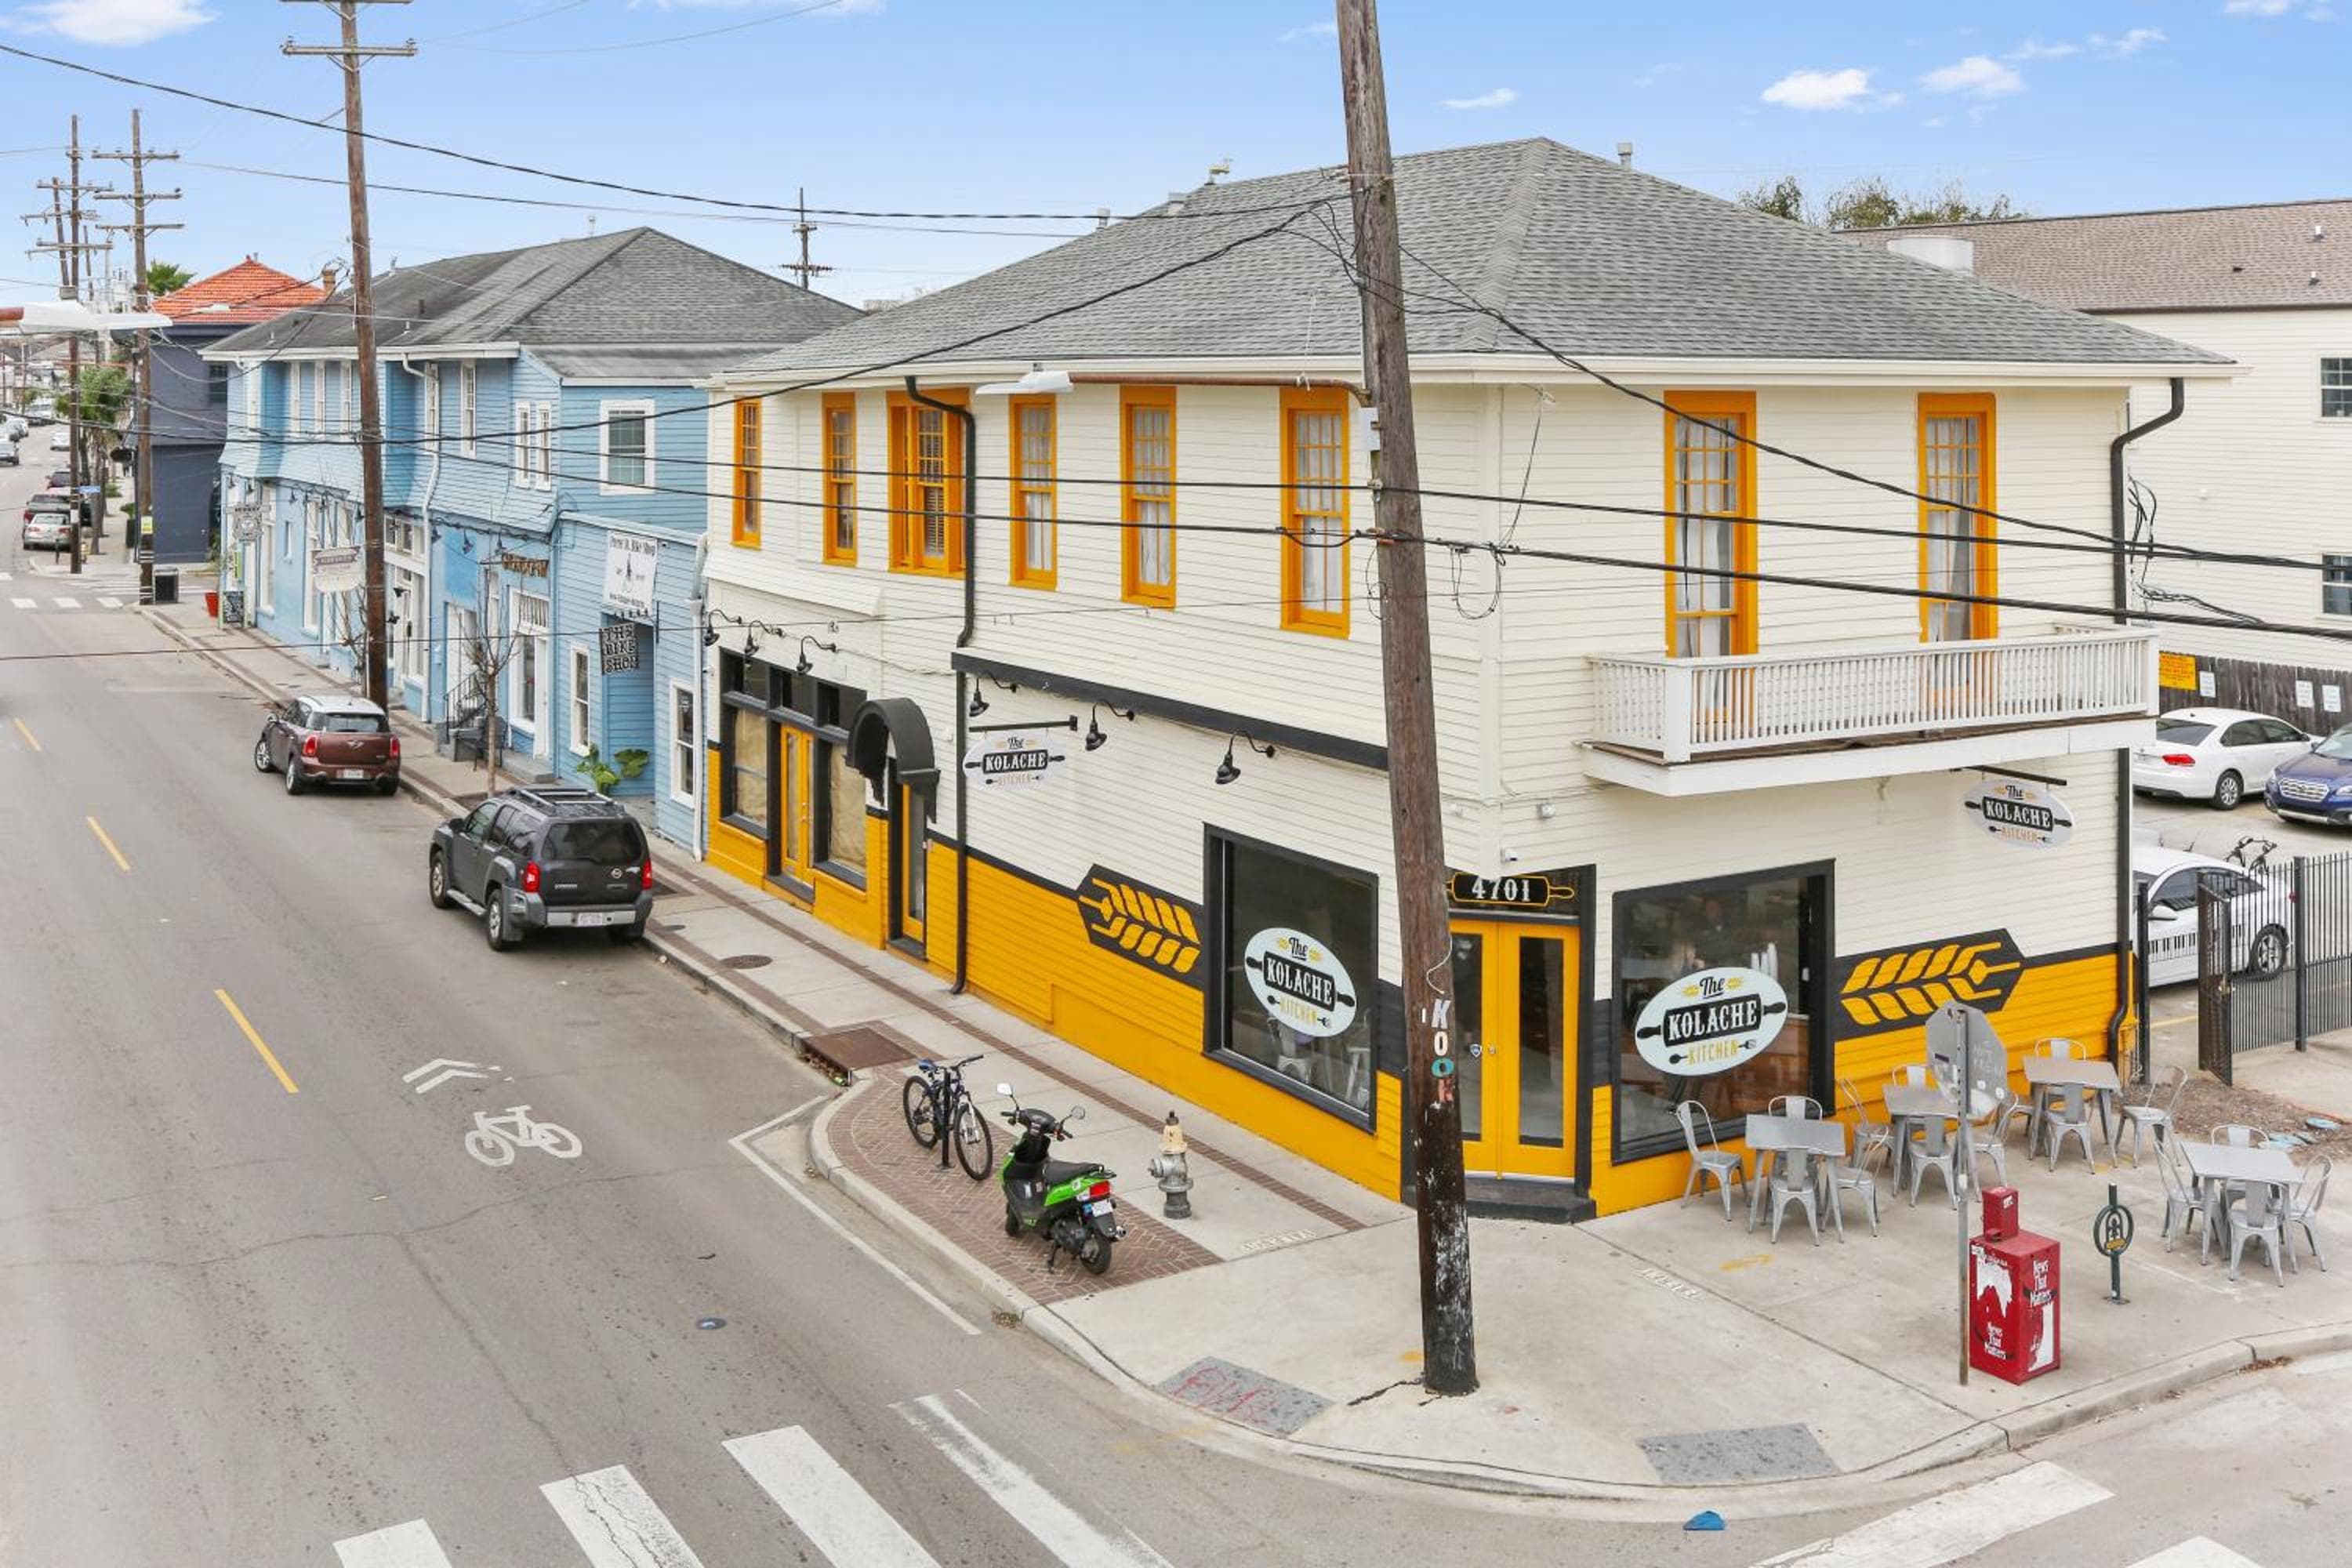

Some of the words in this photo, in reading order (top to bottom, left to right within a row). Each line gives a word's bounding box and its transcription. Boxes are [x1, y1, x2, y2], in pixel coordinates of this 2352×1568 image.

[1007, 736, 1025, 750] The
[985, 753, 1046, 771] KOLACHE
[2005, 785, 2023, 800] The
[1986, 800, 2050, 829] KOLACHE
[1472, 877, 1531, 902] 4701
[1288, 937, 1308, 961] The
[1267, 957, 1332, 1005] KOLACHE
[1699, 976, 1726, 1000] The
[1279, 995, 1318, 1025] KITCHEN
[1668, 1000, 1758, 1040] KOLACHE
[1687, 1040, 1740, 1065] KITCHEN
